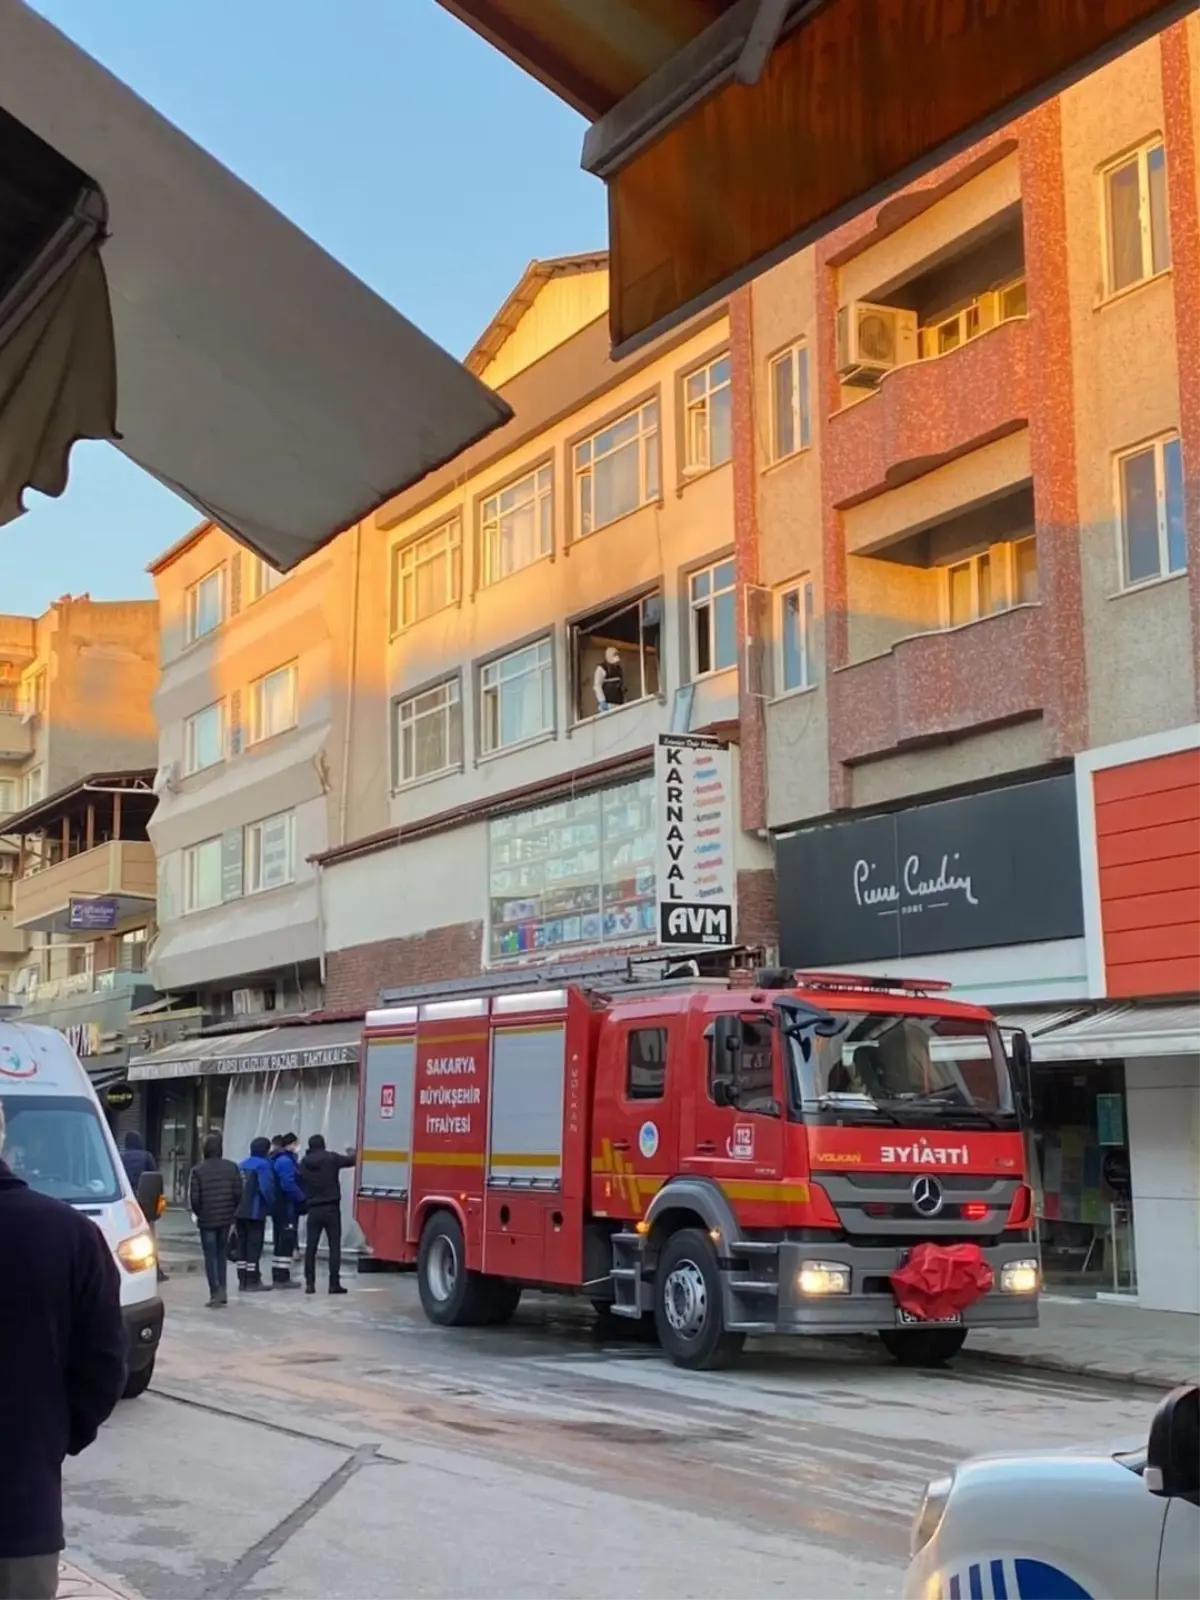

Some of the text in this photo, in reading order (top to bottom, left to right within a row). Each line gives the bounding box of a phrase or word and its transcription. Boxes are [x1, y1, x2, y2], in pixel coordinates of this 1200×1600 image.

[665, 748, 684, 900] KARNAVAL
[853, 853, 979, 905] Pierre Cardin
[668, 907, 727, 936] AVM
[426, 1056, 476, 1075] SAKARYA
[419, 1085, 480, 1108] BÜYÜKŞEHİR
[426, 1113, 471, 1134] İTFAİYESİ
[736, 1128, 751, 1144] 112
[816, 1153, 862, 1162] VOLKAN
